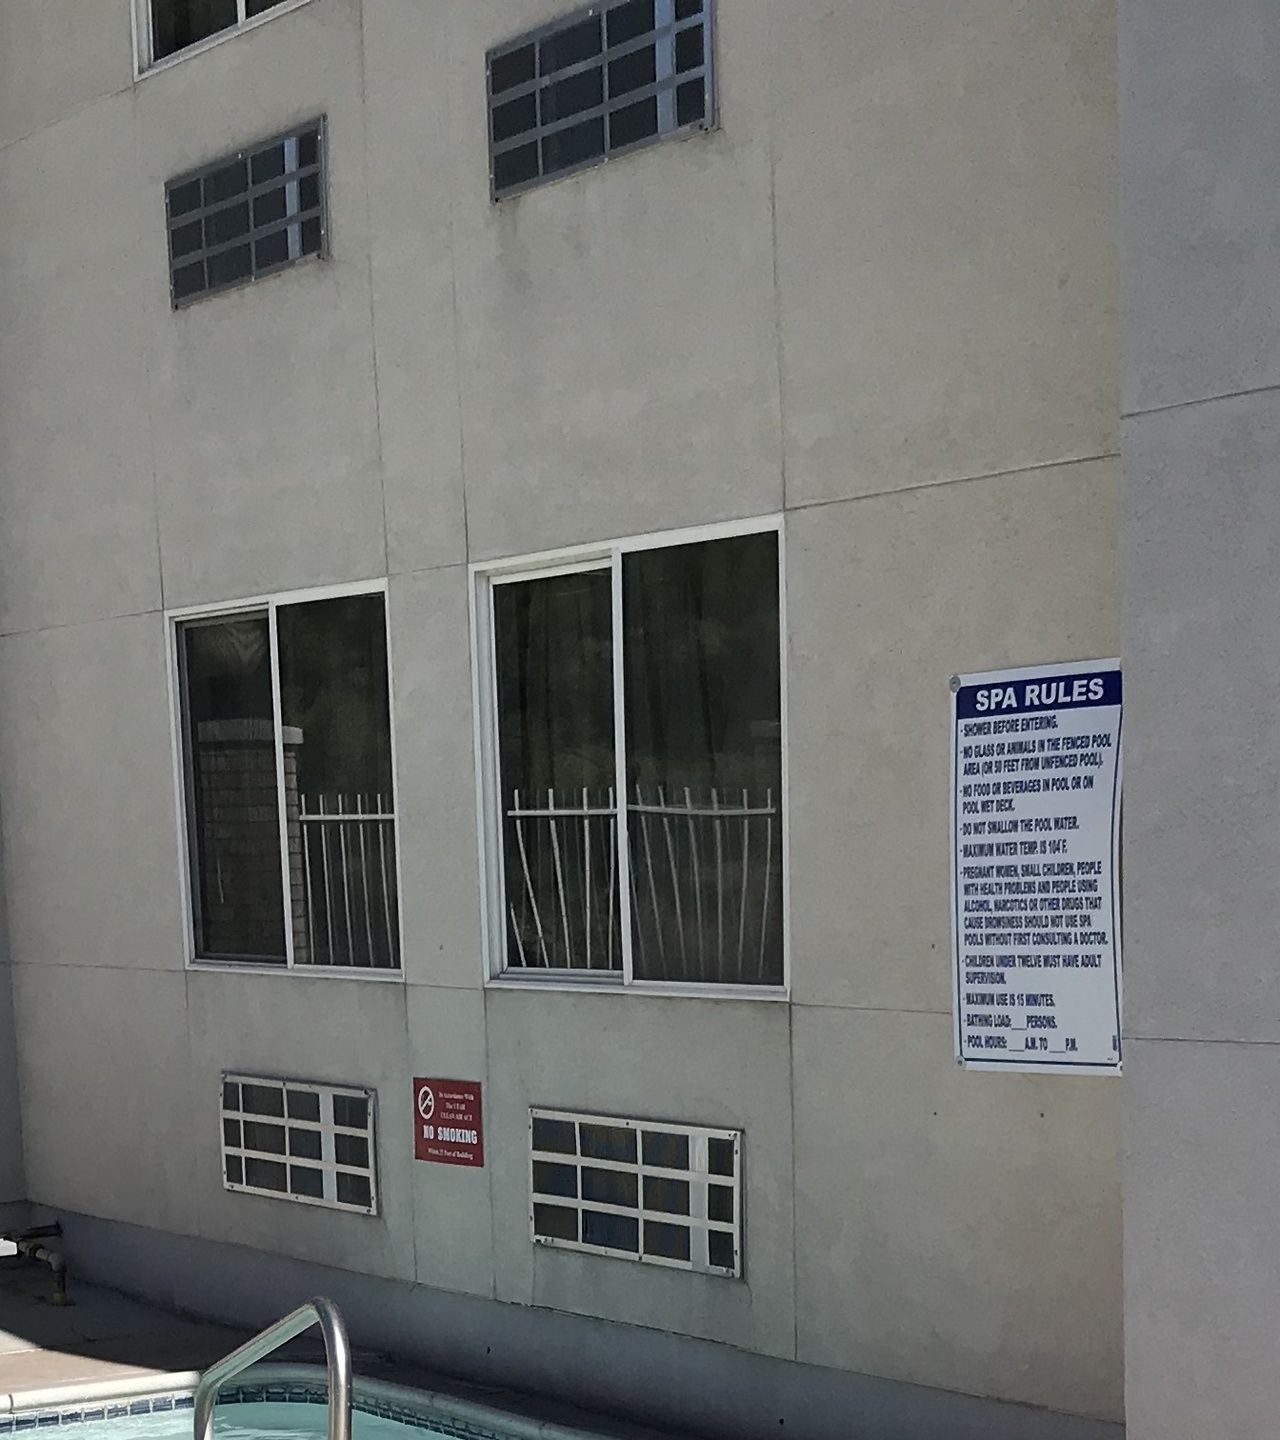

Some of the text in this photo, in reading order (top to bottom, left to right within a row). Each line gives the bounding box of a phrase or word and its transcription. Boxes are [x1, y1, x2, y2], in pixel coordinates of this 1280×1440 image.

[976, 679, 1103, 711] SPA RULES
[423, 1125, 477, 1144] NO SMOKING
